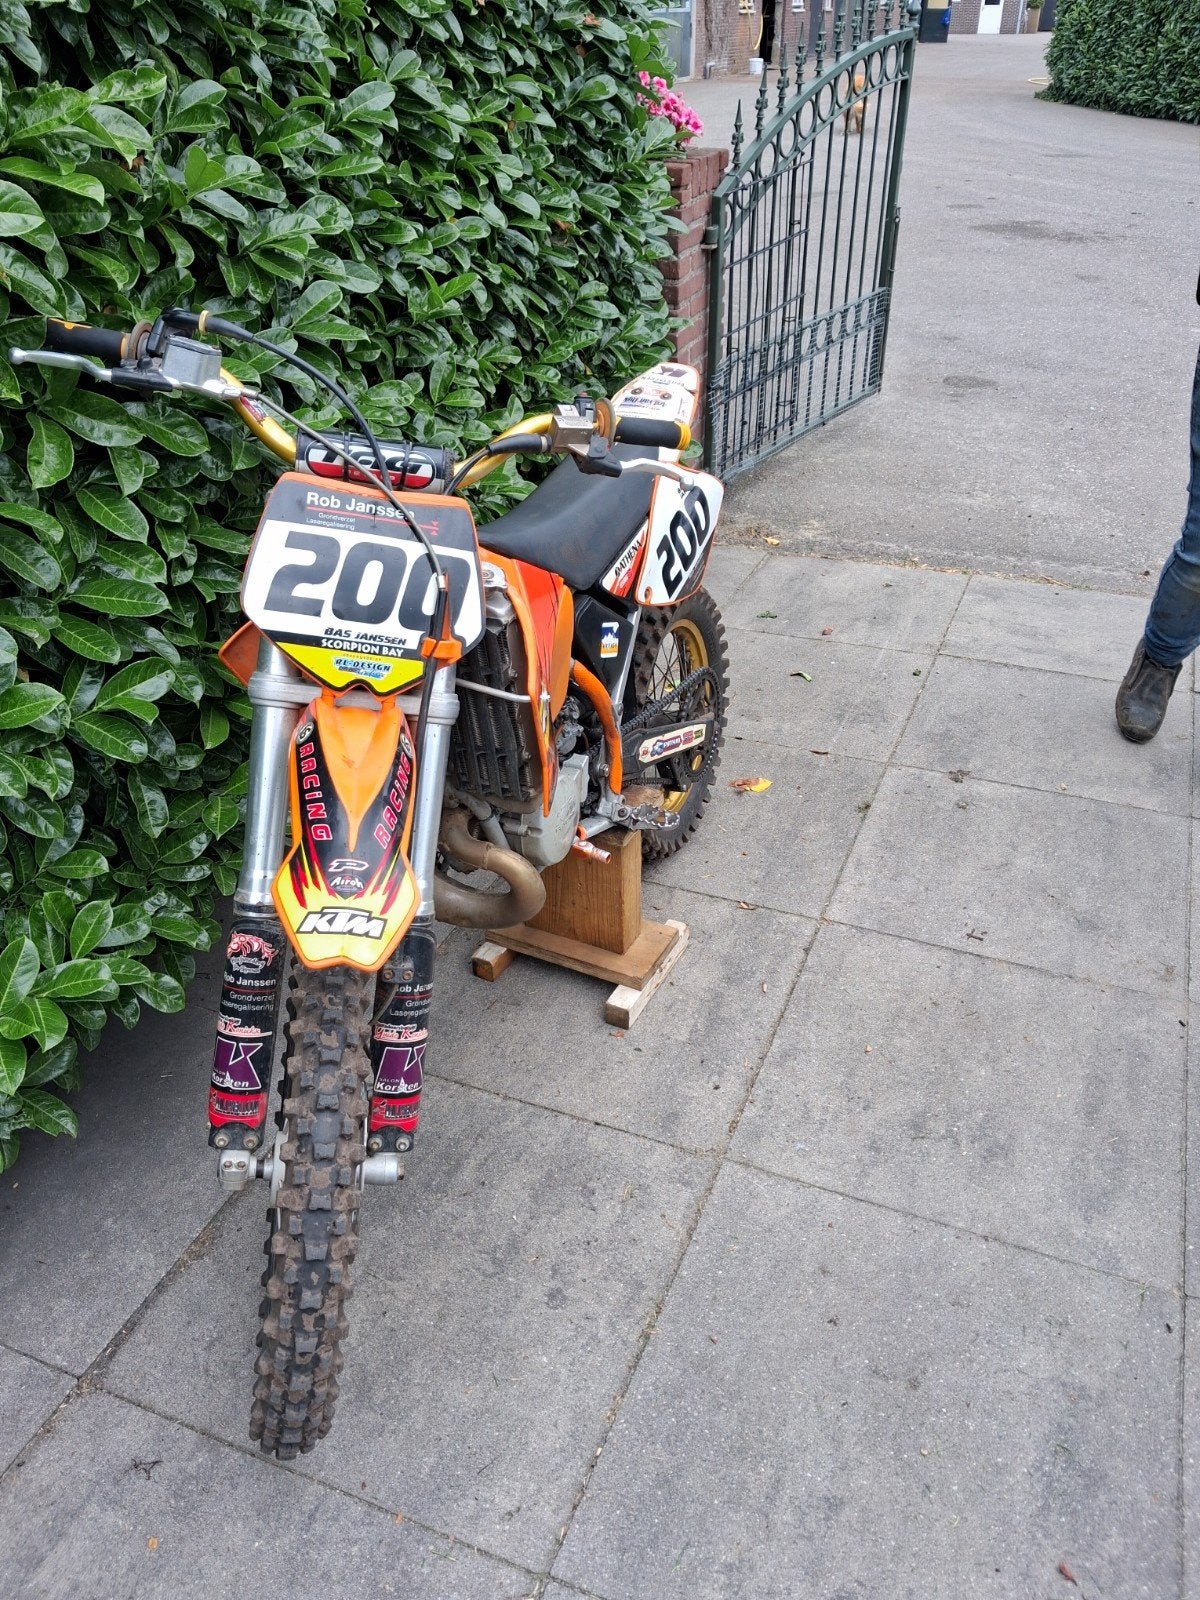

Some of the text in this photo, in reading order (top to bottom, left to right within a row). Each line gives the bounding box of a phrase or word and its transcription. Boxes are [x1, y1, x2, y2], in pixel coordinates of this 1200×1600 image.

[307, 492, 340, 509] Rob
[656, 486, 710, 599] 200
[264, 530, 470, 631] 200
[324, 627, 407, 646] BAS JANSSEN
[321, 638, 379, 655] SCORPION
[382, 646, 404, 657] BAY
[330, 875, 364, 889] Airoh
[299, 908, 387, 939] KTM
[236, 977, 276, 987] Janssen
[229, 991, 275, 1002] Grondverzet
[376, 1080, 420, 1092] Korsten
